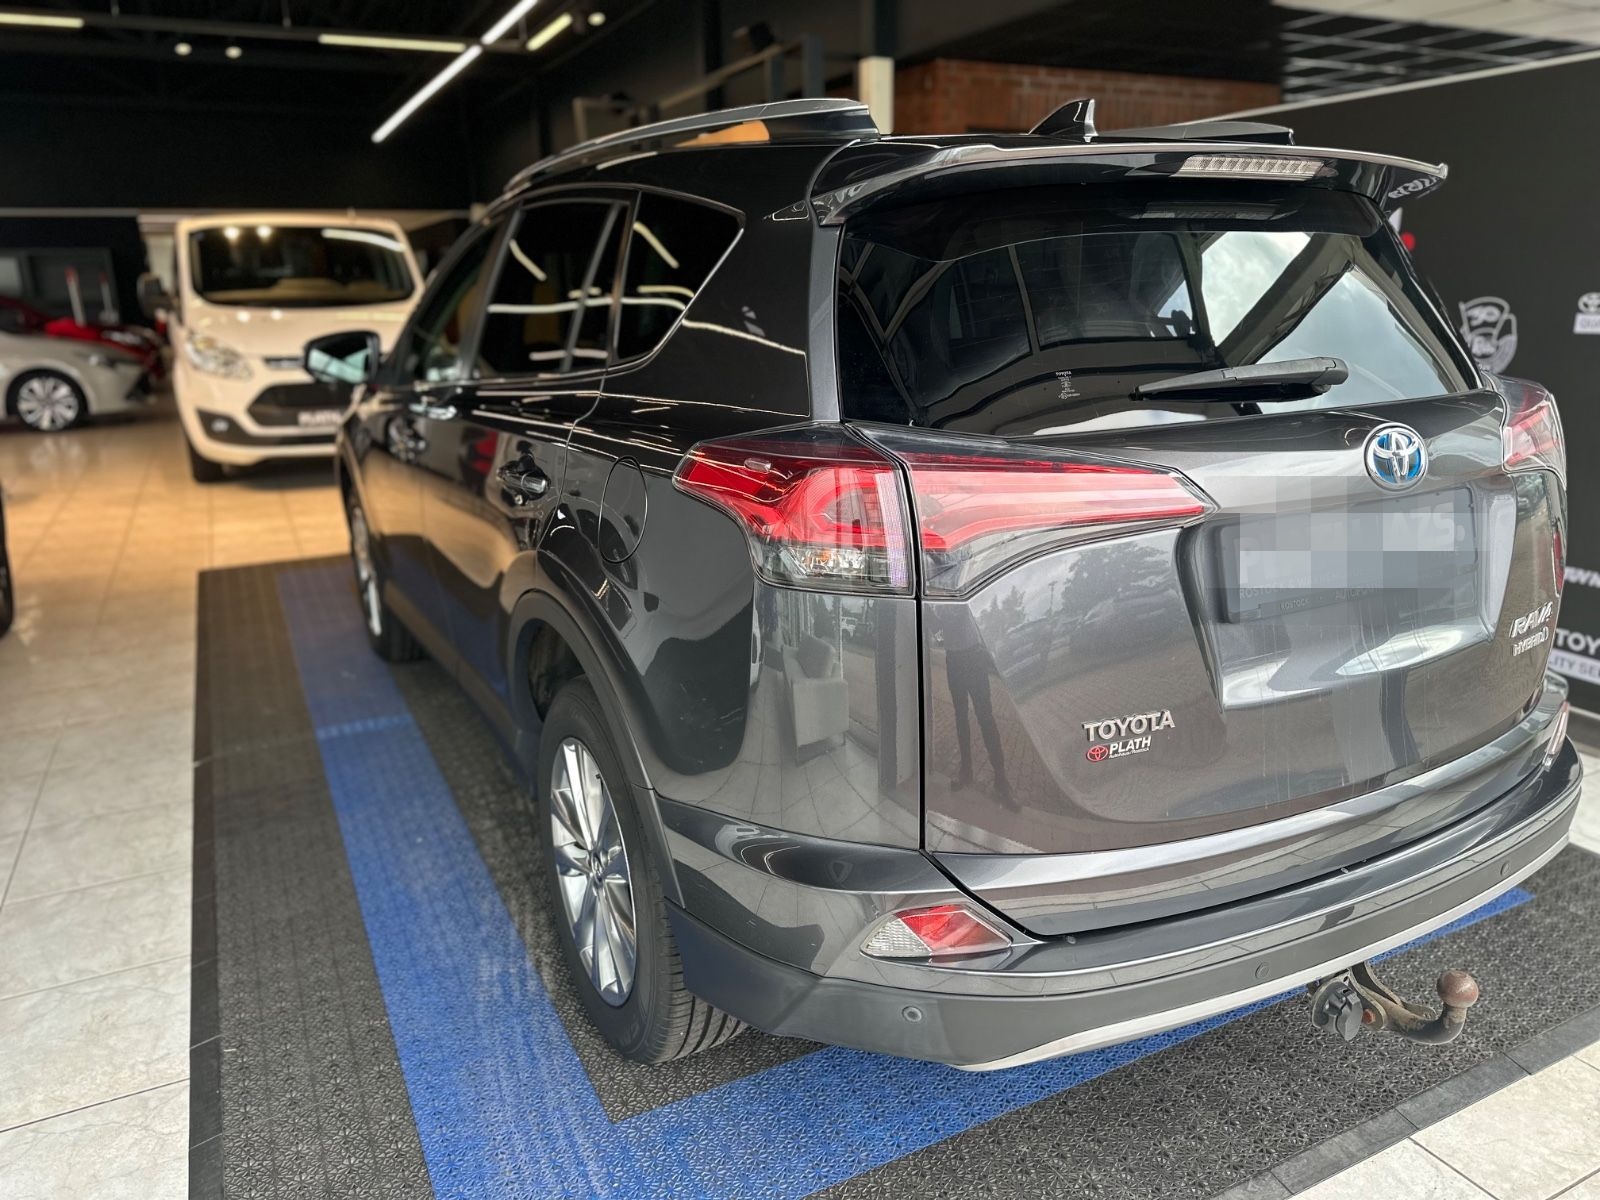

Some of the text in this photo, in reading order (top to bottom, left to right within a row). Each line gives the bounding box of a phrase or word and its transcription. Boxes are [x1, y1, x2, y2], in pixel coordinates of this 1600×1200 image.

[1280, 598, 1310, 610] ROSTOCK
[1082, 709, 1176, 742] TOYOTA
[1108, 736, 1151, 755] PLATH
